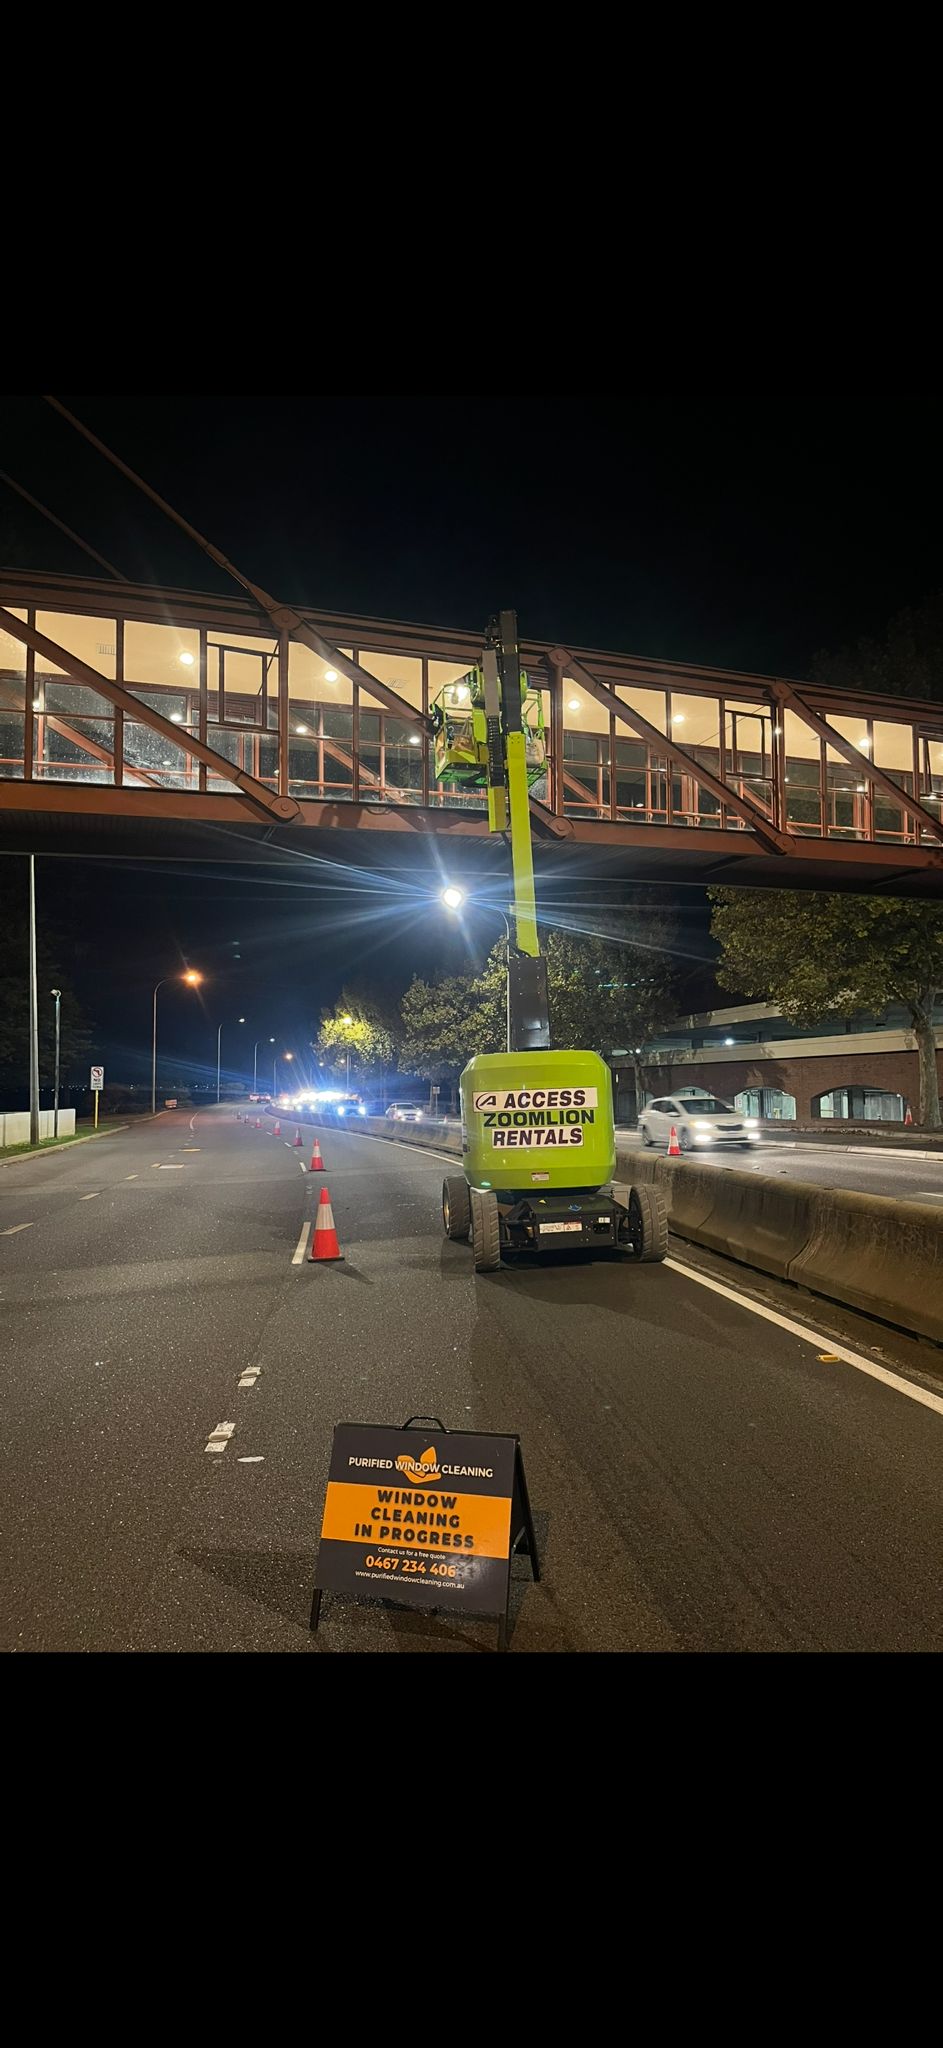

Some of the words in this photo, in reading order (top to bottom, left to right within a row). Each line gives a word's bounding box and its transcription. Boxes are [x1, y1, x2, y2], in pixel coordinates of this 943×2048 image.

[503, 1090, 586, 1109] ACCESS
[483, 1110, 595, 1127] ZOOMLION
[493, 1128, 582, 1146] RENTALS
[348, 1457, 393, 1469] PURIFIED
[395, 1460, 441, 1473] WINDOW
[441, 1464, 494, 1478] CLEANING
[377, 1490, 458, 1509] WINDOW
[371, 1507, 460, 1529] CLEANING
[354, 1523, 373, 1538] IN
[379, 1526, 475, 1548] PROGRESS
[377, 1546, 399, 1555] Contact
[365, 1555, 399, 1570] 0467
[401, 1559, 427, 1574] 234
[429, 1563, 457, 1578] 406
[355, 1570, 465, 1589] www.purifiedwindowcleaning.com.au
